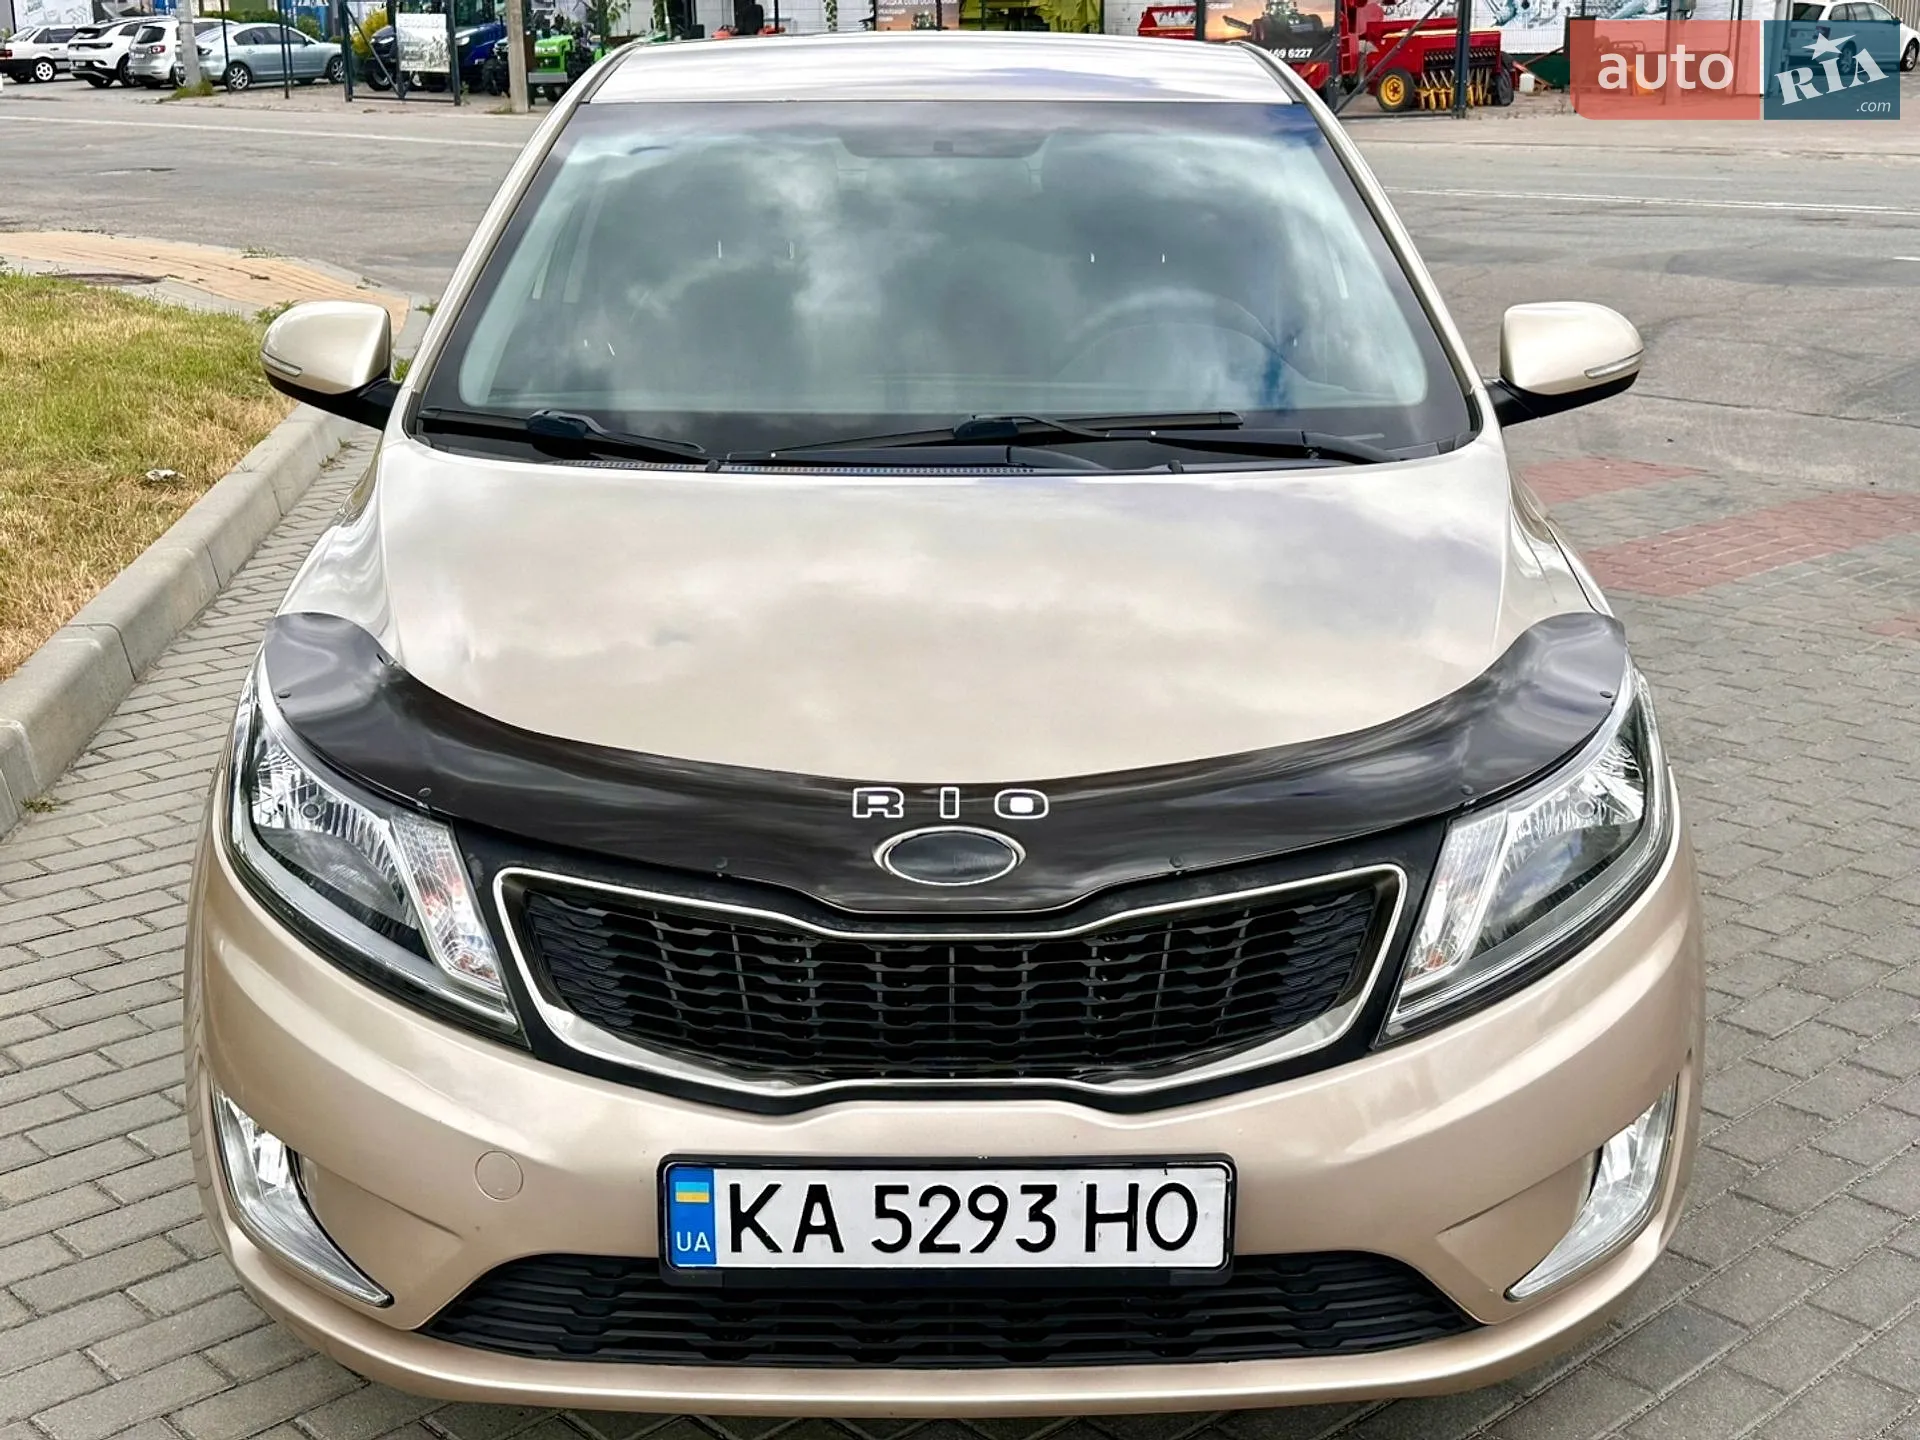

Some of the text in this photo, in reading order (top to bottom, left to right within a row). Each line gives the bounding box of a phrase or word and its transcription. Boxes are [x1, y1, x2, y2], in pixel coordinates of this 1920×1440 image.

[852, 786, 1050, 820] RIO
[729, 1182, 1199, 1254] KA 5293 HO
[676, 1231, 711, 1252] UA
